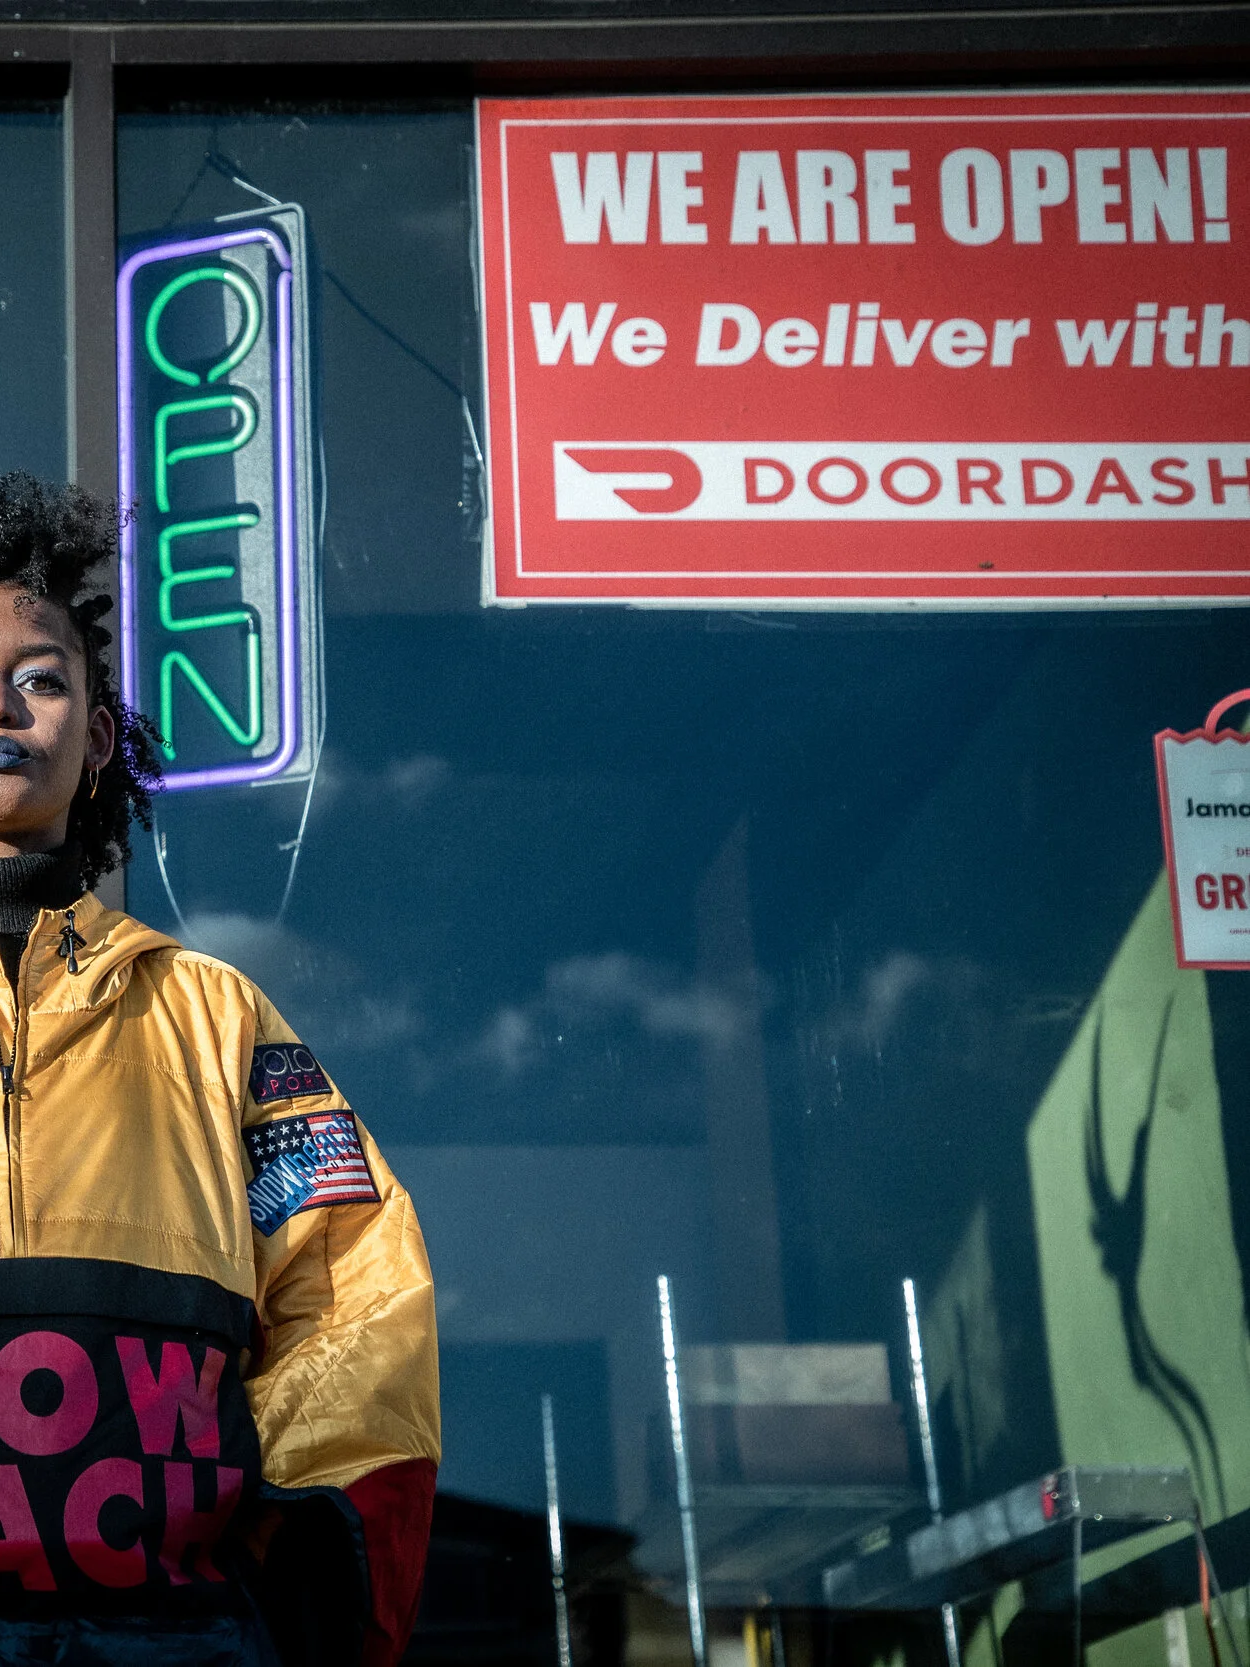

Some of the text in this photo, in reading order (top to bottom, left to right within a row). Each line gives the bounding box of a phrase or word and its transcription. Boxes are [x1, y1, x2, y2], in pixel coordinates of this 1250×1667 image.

[551, 146, 1232, 247] WE ARE OPEN!
[529, 302, 1250, 369] We Deliver with
[743, 456, 1250, 507] DOORDASH
[144, 266, 262, 761] OPEN
[1195, 873, 1250, 911] GR
[253, 1048, 316, 1081] POLO
[255, 1074, 325, 1097] SPORT
